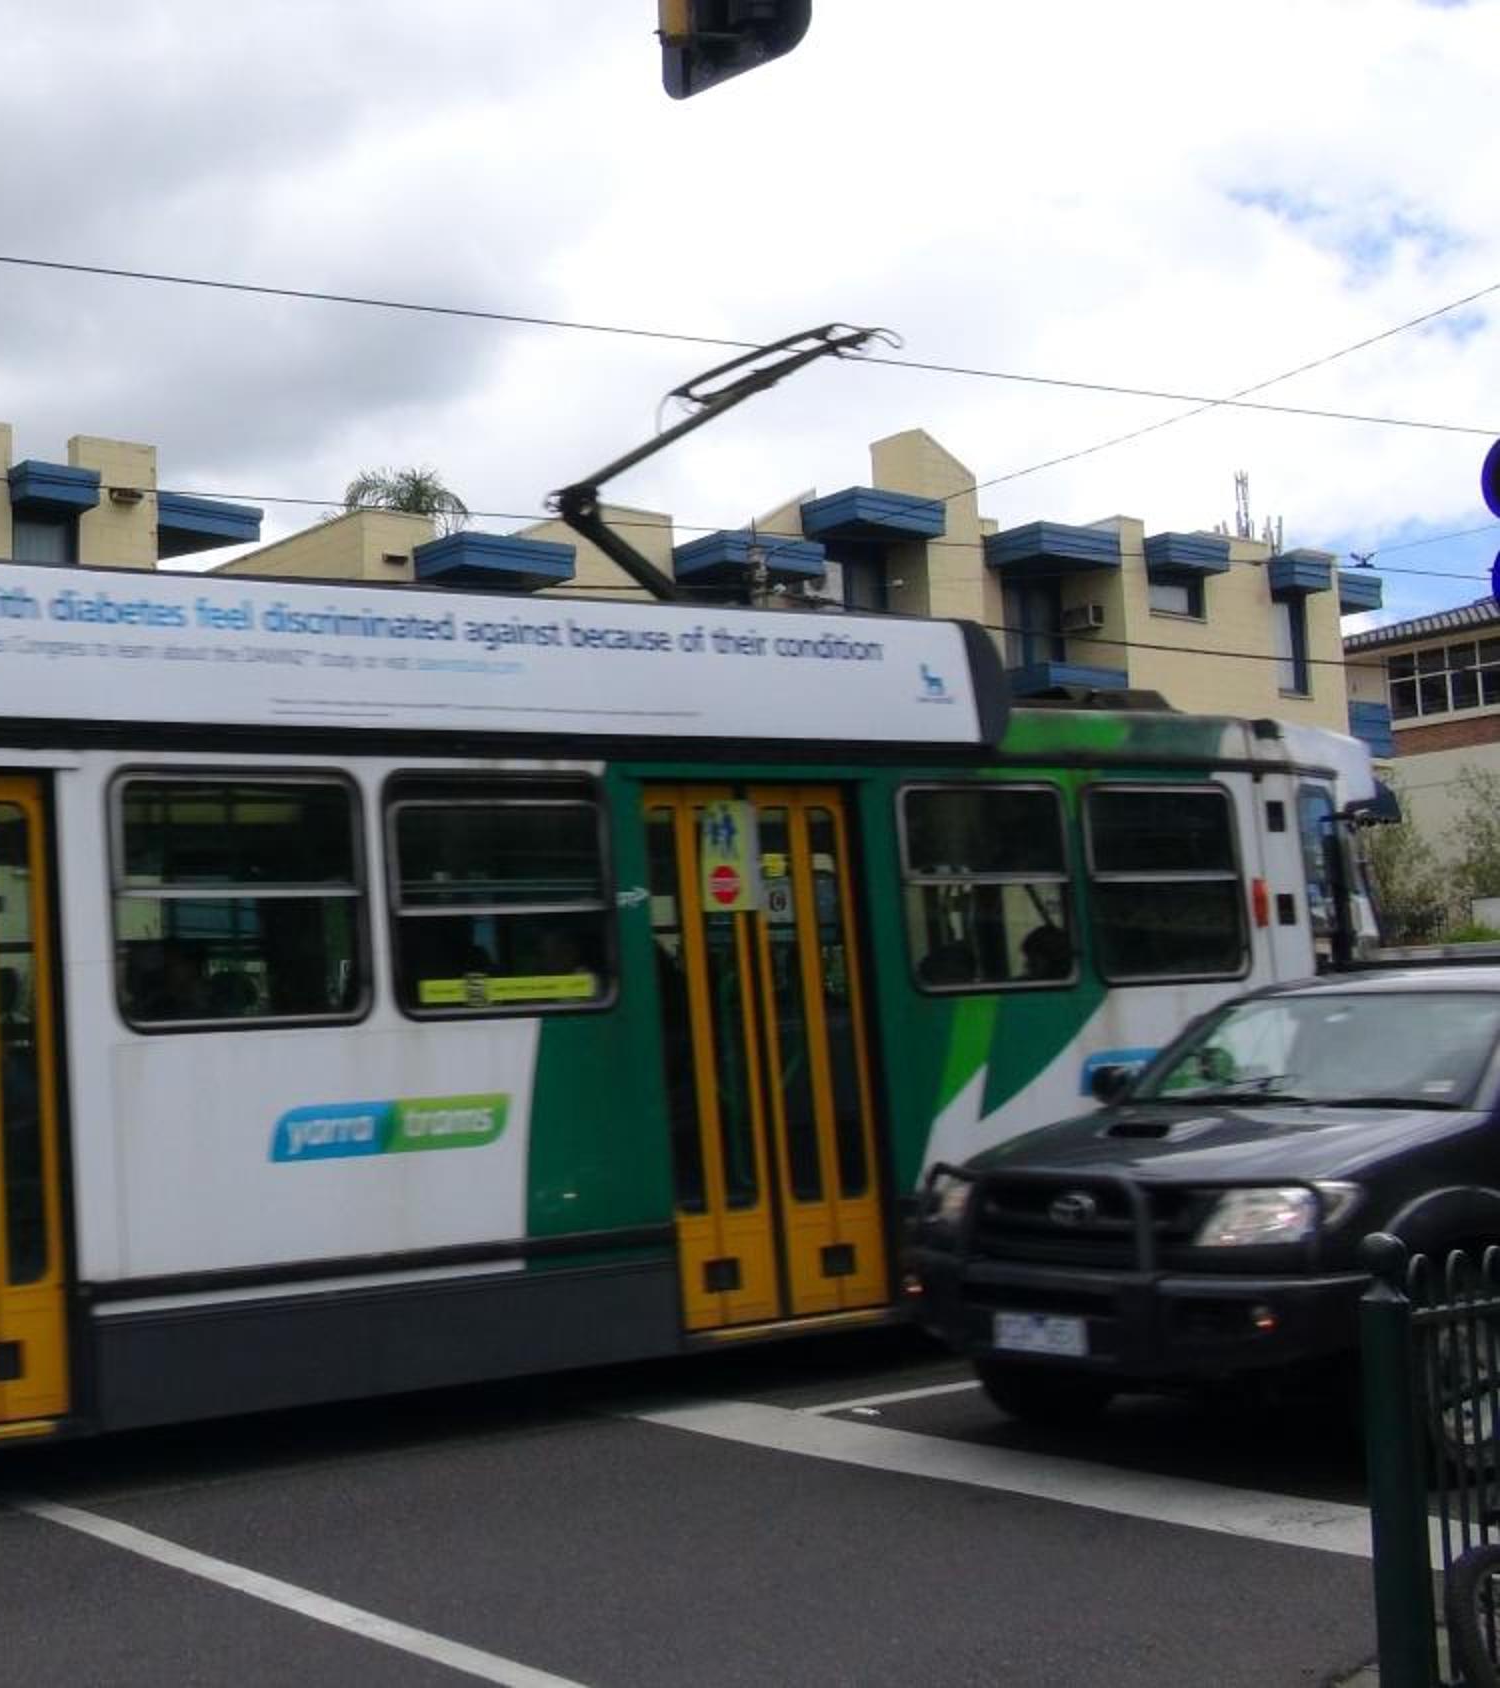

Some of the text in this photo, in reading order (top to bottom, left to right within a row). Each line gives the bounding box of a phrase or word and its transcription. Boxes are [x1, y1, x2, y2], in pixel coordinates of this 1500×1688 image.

[48, 587, 187, 628] diabetes
[195, 595, 254, 631] feel
[262, 601, 456, 641] discriminated
[463, 613, 563, 651] against
[568, 619, 671, 653] because
[678, 624, 706, 654] of
[711, 627, 767, 658] their
[775, 632, 885, 663] condition
